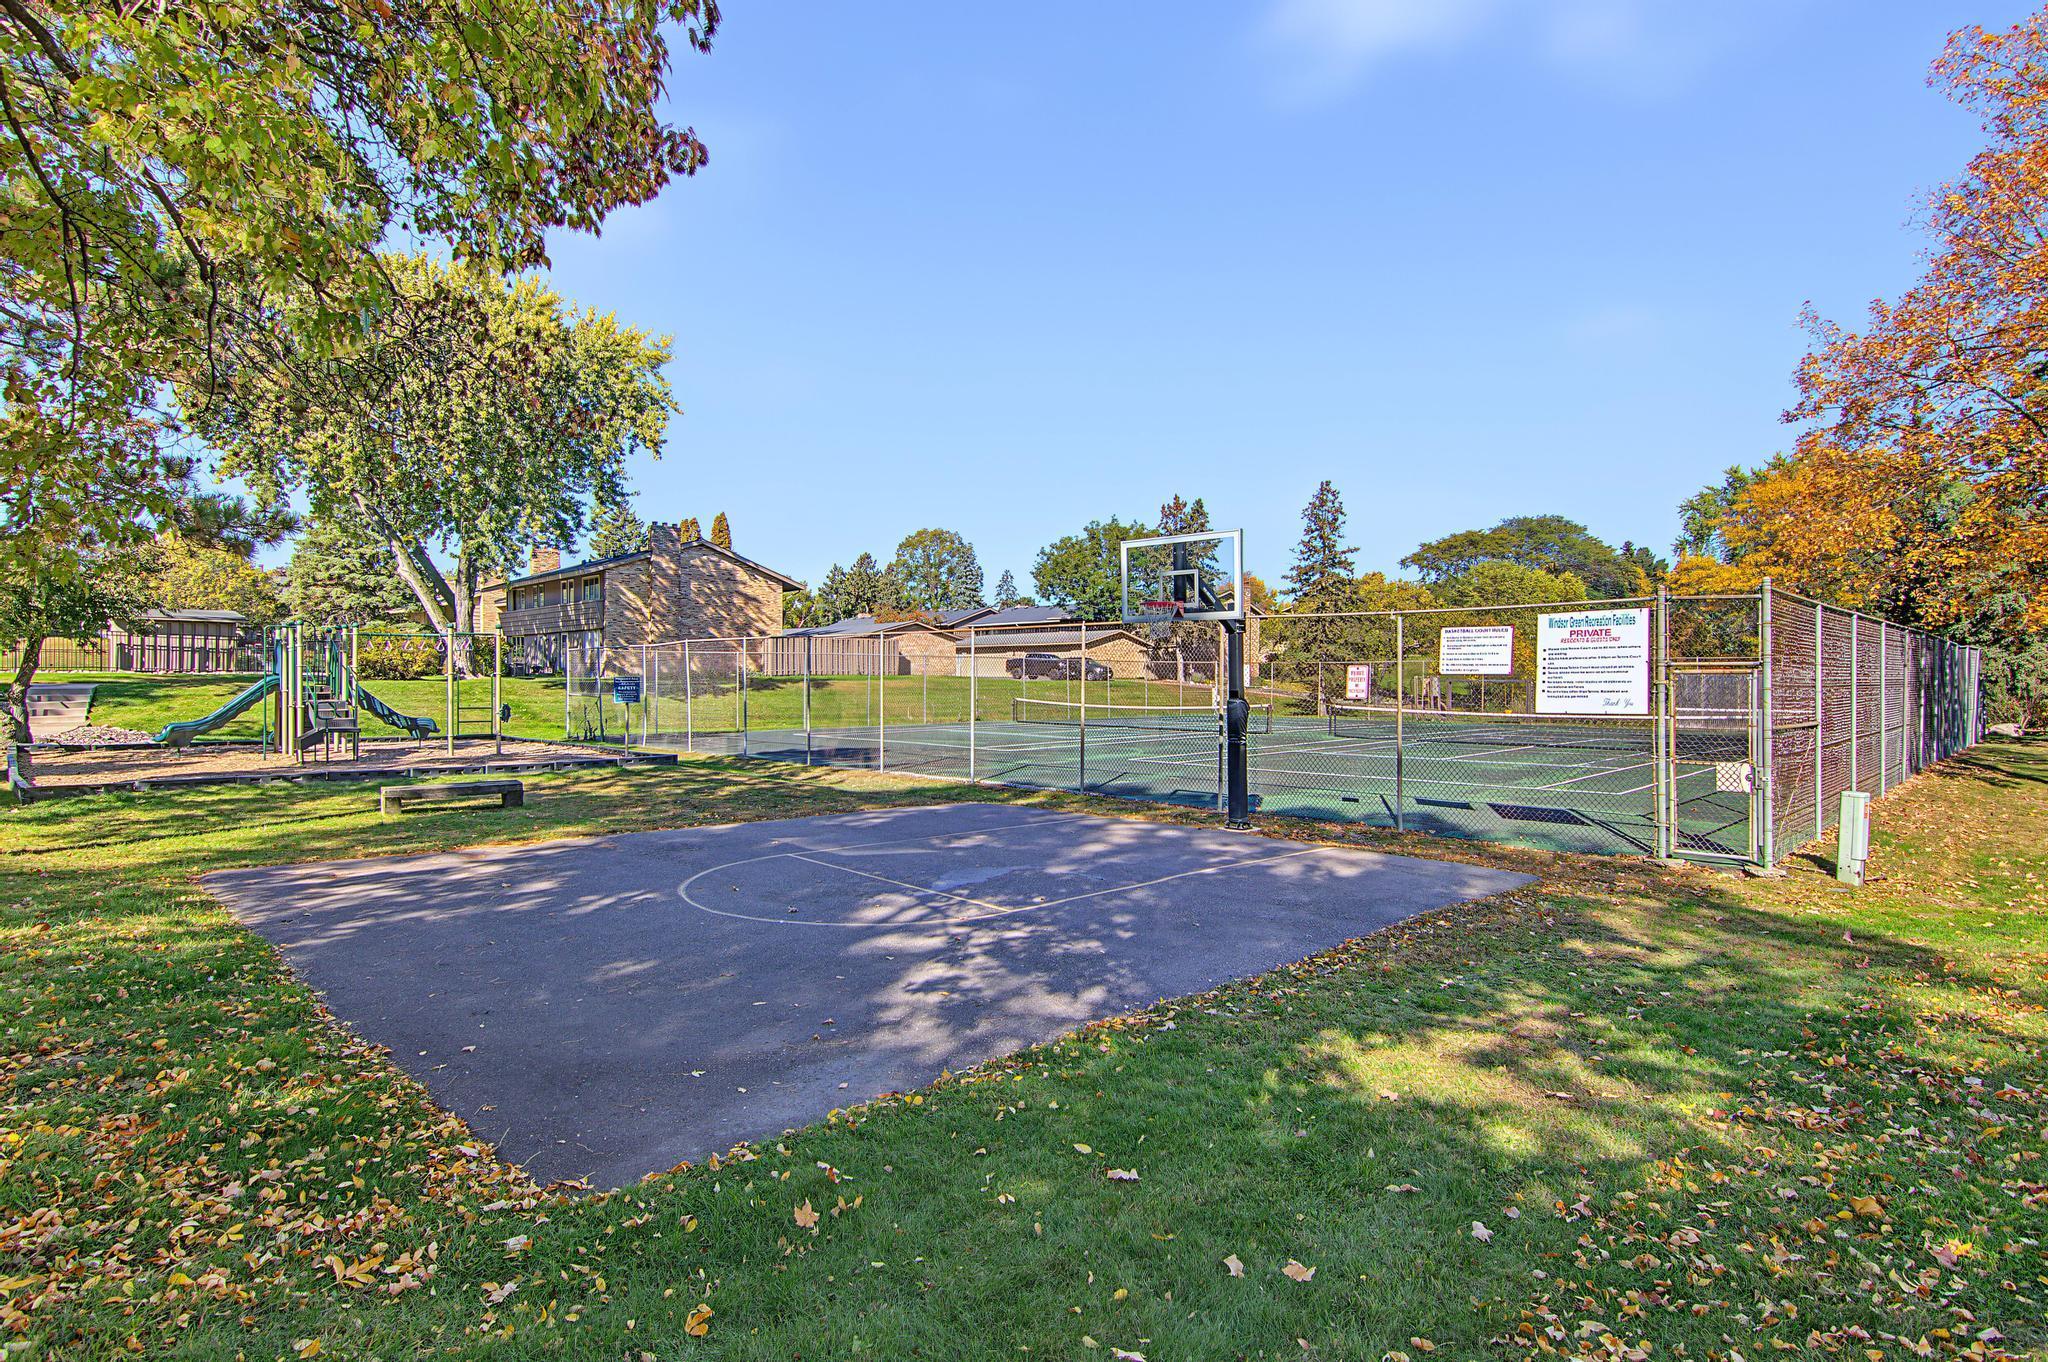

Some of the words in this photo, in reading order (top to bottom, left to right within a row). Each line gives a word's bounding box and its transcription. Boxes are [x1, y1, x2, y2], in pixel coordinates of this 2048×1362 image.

[1549, 618, 1569, 628] Windsor
[1569, 616, 1585, 629] Green
[1585, 615, 1612, 627] Recreation
[1612, 613, 1636, 626] Facilities
[1569, 628, 1612, 637] PRIVATE
